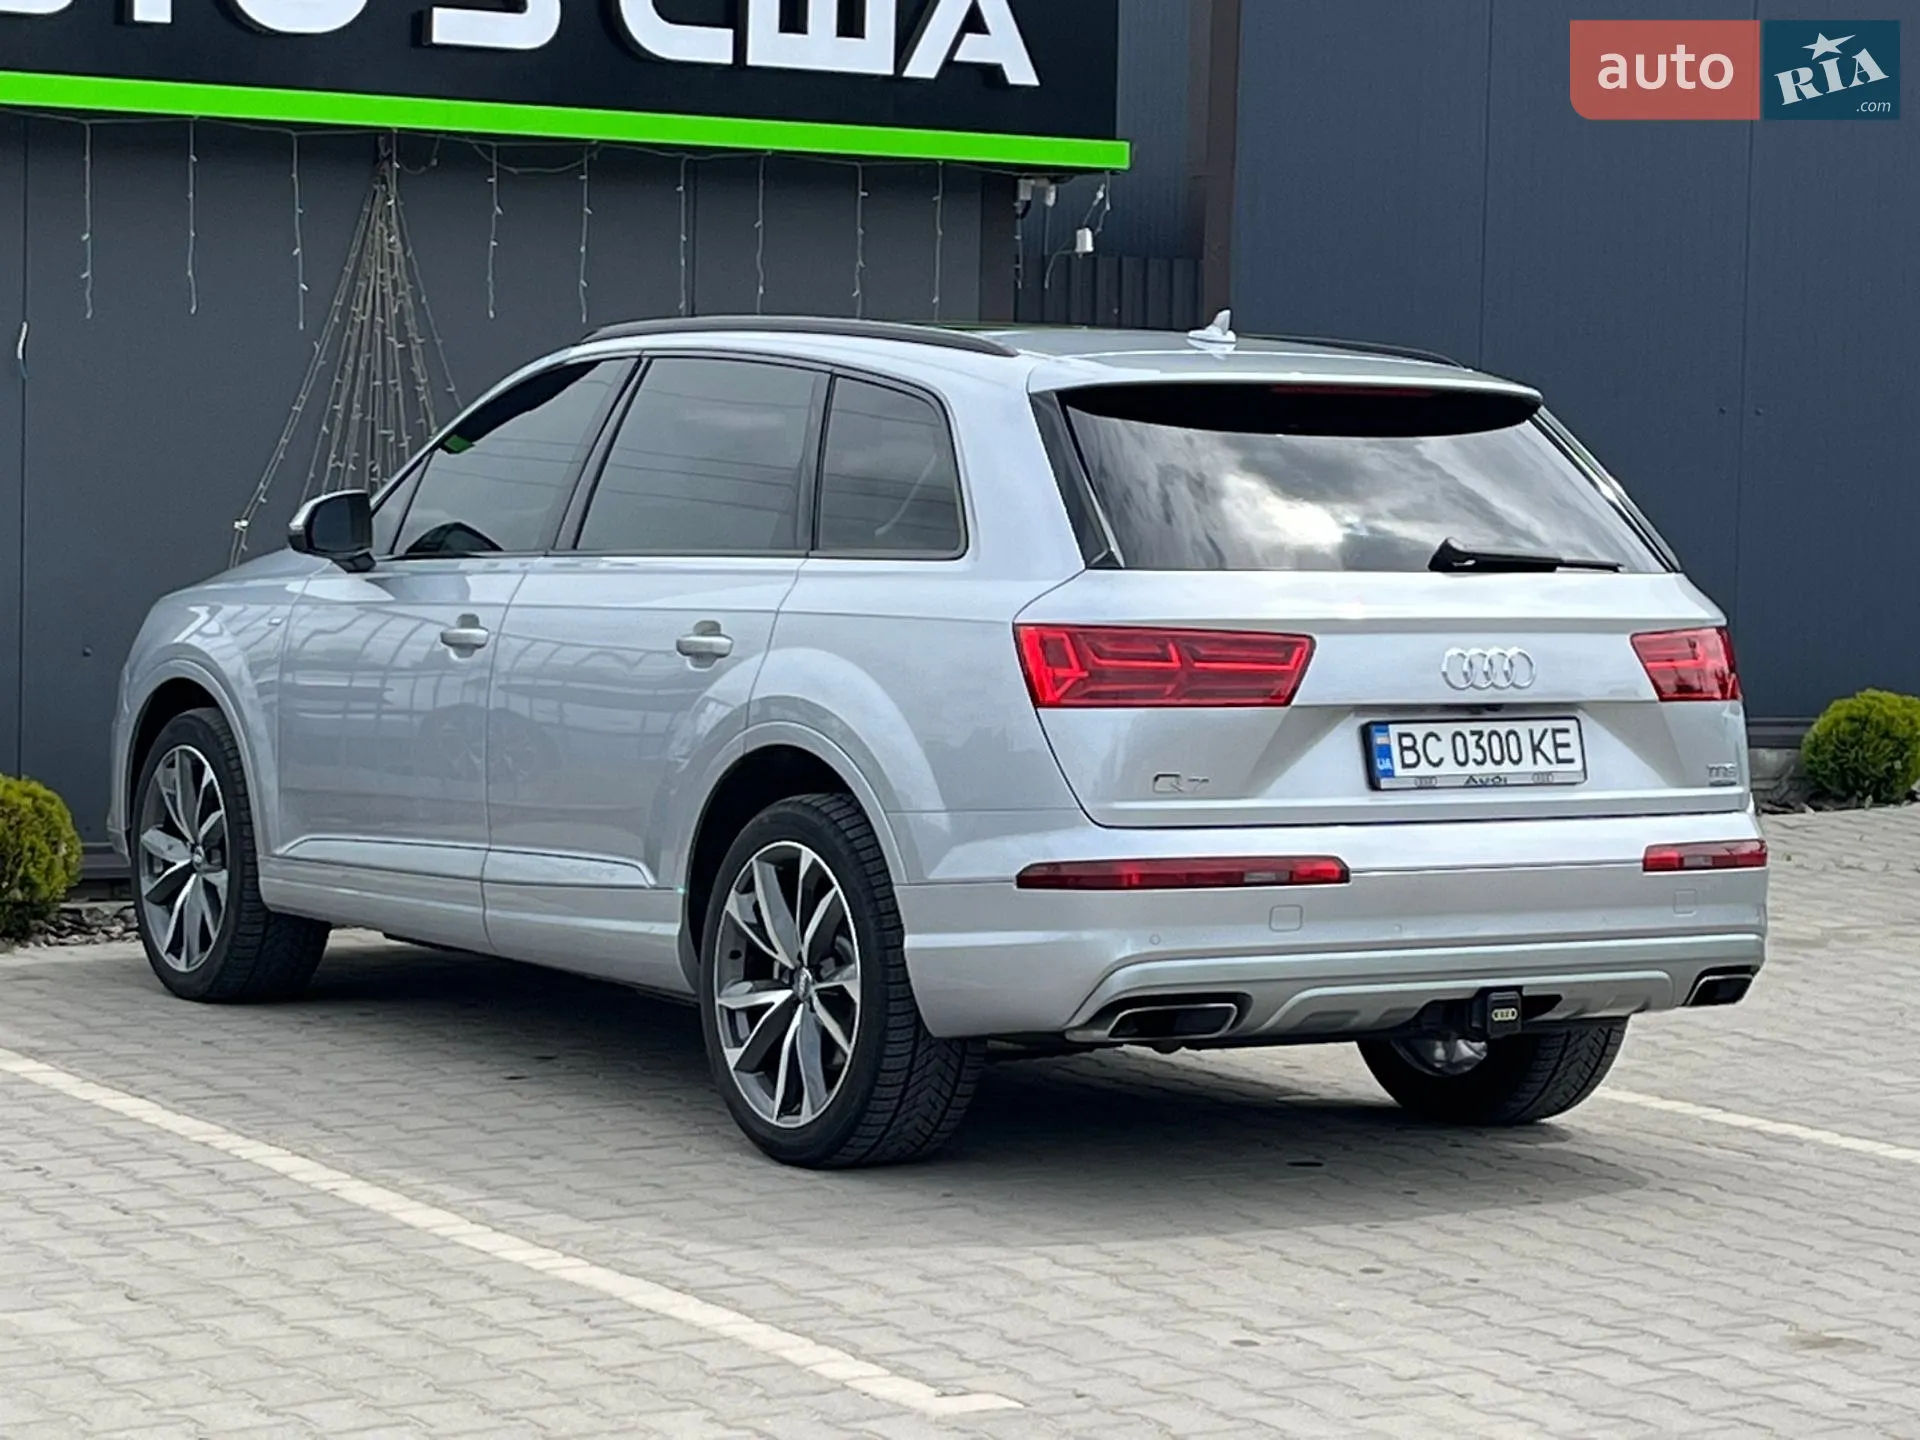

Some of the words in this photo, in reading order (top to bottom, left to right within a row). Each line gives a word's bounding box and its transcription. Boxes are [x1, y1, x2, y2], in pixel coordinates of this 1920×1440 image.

[1398, 731, 1444, 769] BC
[1451, 729, 1523, 767] 0300
[1528, 728, 1575, 765] KE
